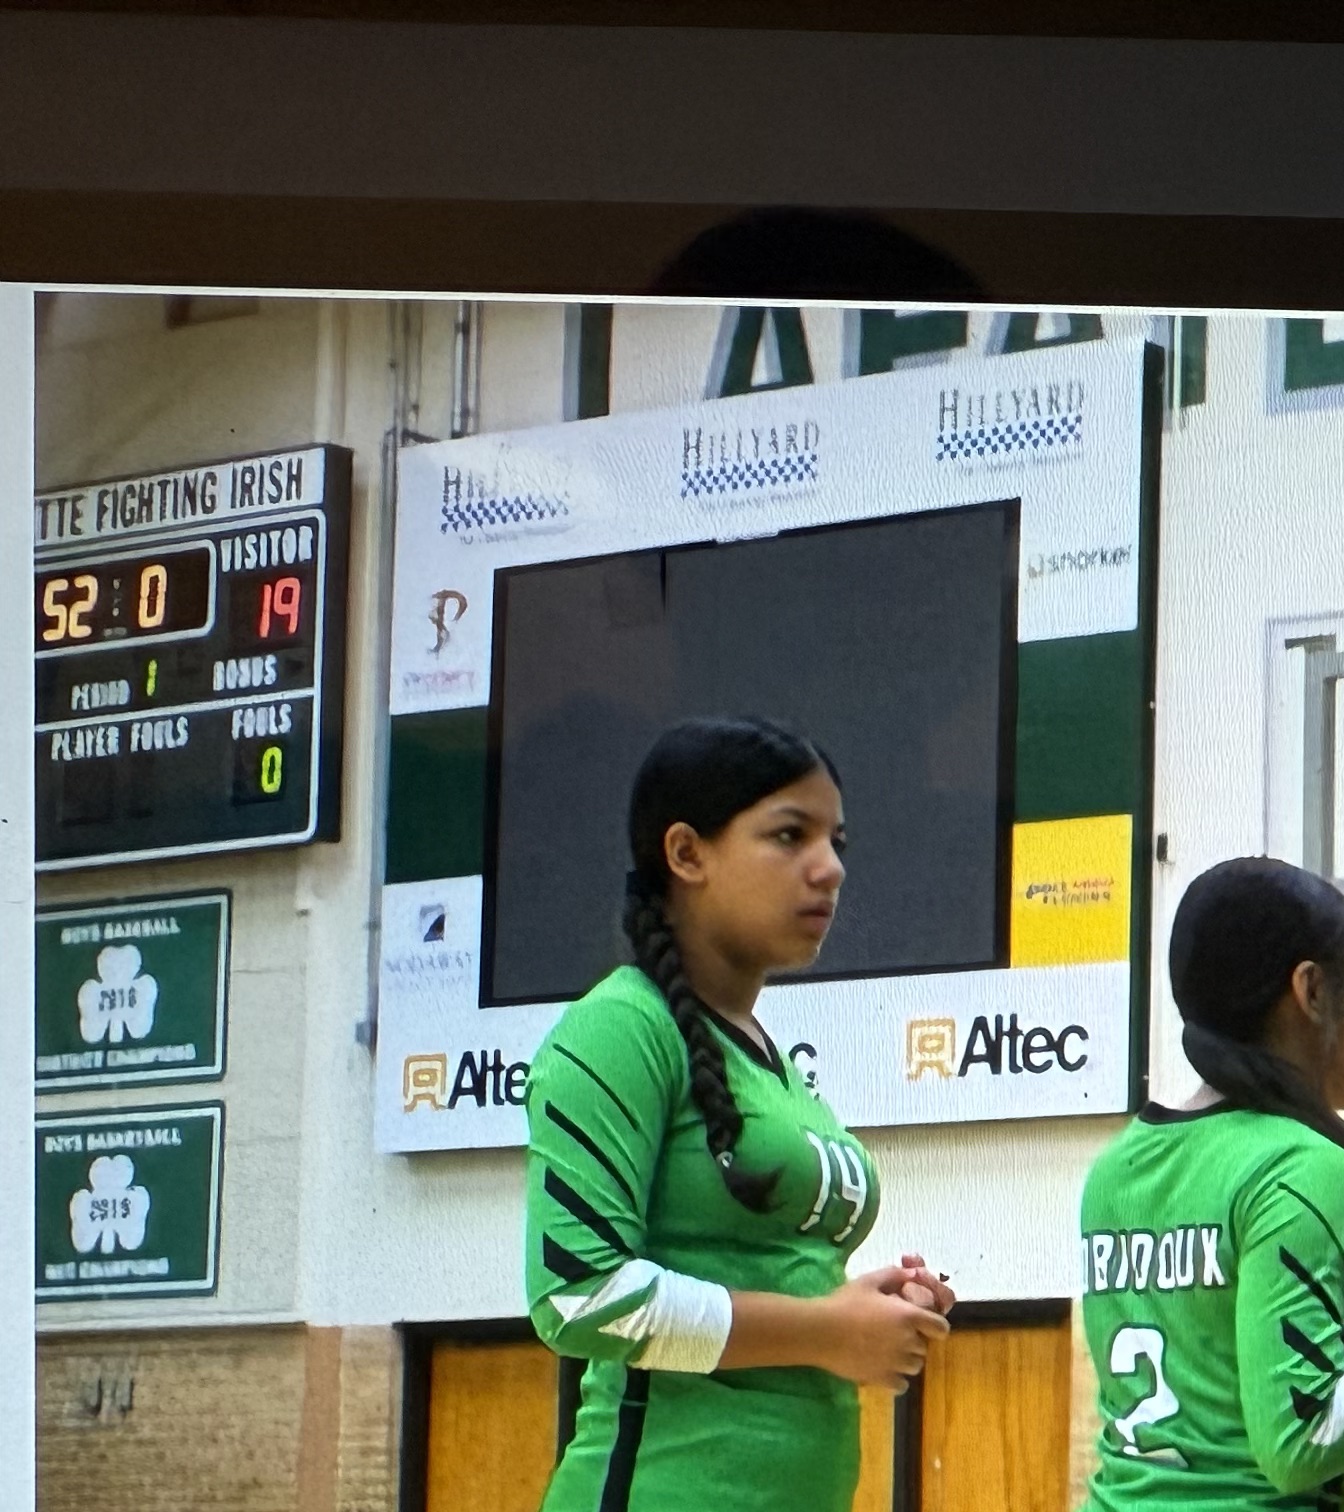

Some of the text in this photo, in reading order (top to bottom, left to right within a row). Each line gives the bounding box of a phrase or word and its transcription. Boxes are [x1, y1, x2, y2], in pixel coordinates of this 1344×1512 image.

[96, 472, 218, 531] FIGHTING
[230, 457, 303, 510] IRISH
[220, 524, 314, 572] VISITOR
[258, 576, 301, 638] 19
[130, 716, 189, 753] FOULS
[231, 703, 292, 741] FOULS
[261, 746, 283, 795] 0
[957, 1012, 1089, 1078] Altec
[448, 1048, 532, 1110] Alte
[1110, 1327, 1190, 1469] 2
